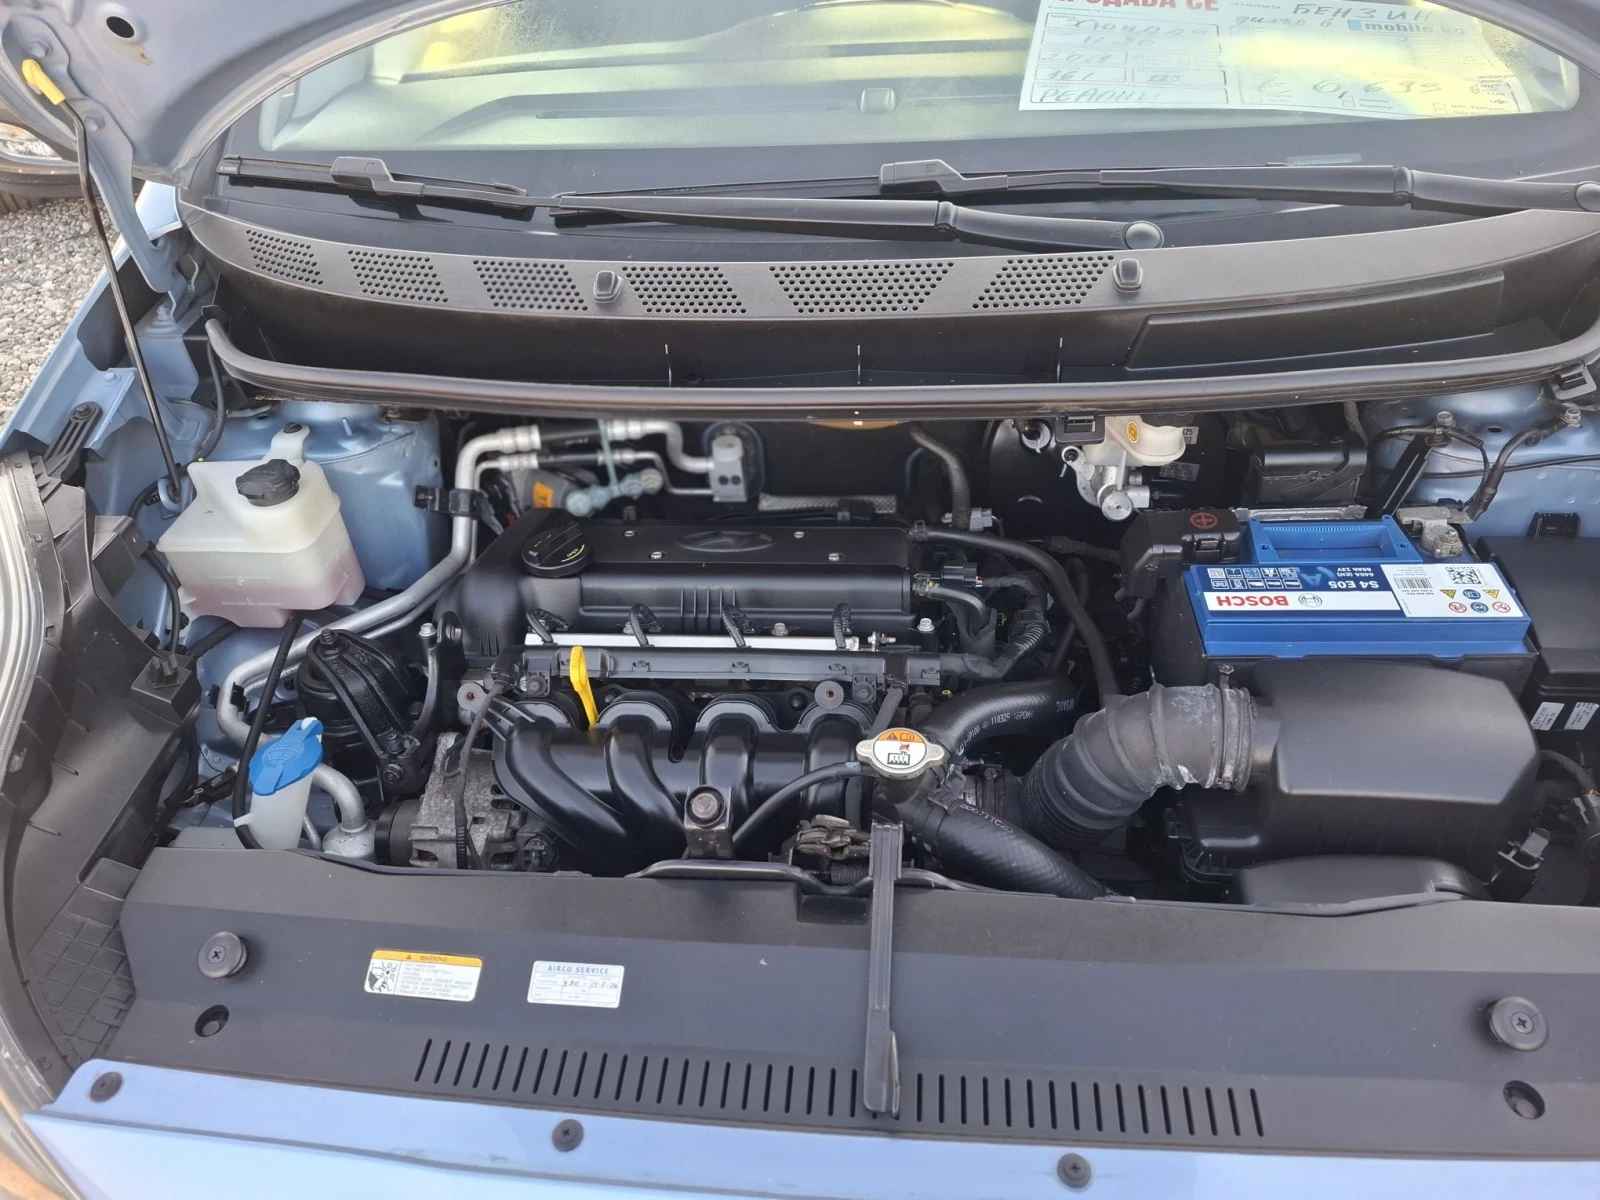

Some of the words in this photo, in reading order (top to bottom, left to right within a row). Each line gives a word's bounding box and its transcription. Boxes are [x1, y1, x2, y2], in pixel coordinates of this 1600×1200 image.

[1328, 580, 1357, 589] E05
[1359, 580, 1380, 589] S4
[1216, 595, 1290, 607] BOSCH
[547, 964, 572, 973] AIRCO
[574, 966, 609, 975] SERVICE
